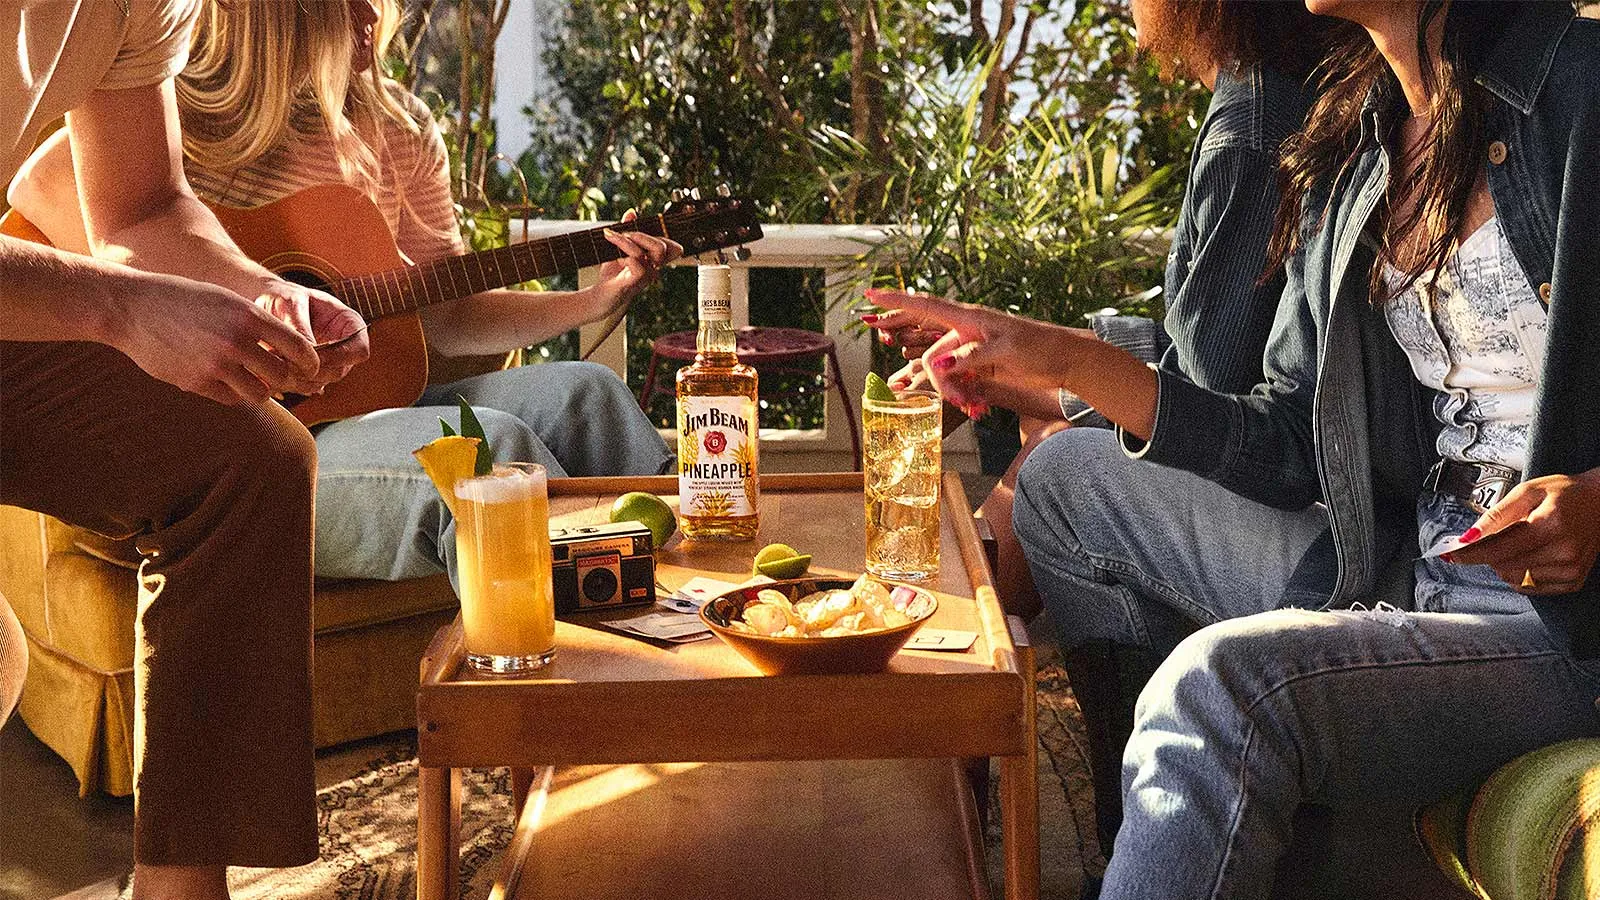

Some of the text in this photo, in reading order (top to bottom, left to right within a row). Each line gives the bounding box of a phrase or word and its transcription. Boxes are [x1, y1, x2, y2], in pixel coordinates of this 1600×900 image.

[683, 407, 749, 437] JIM BEAM
[683, 462, 752, 479] PINEAPPLE
